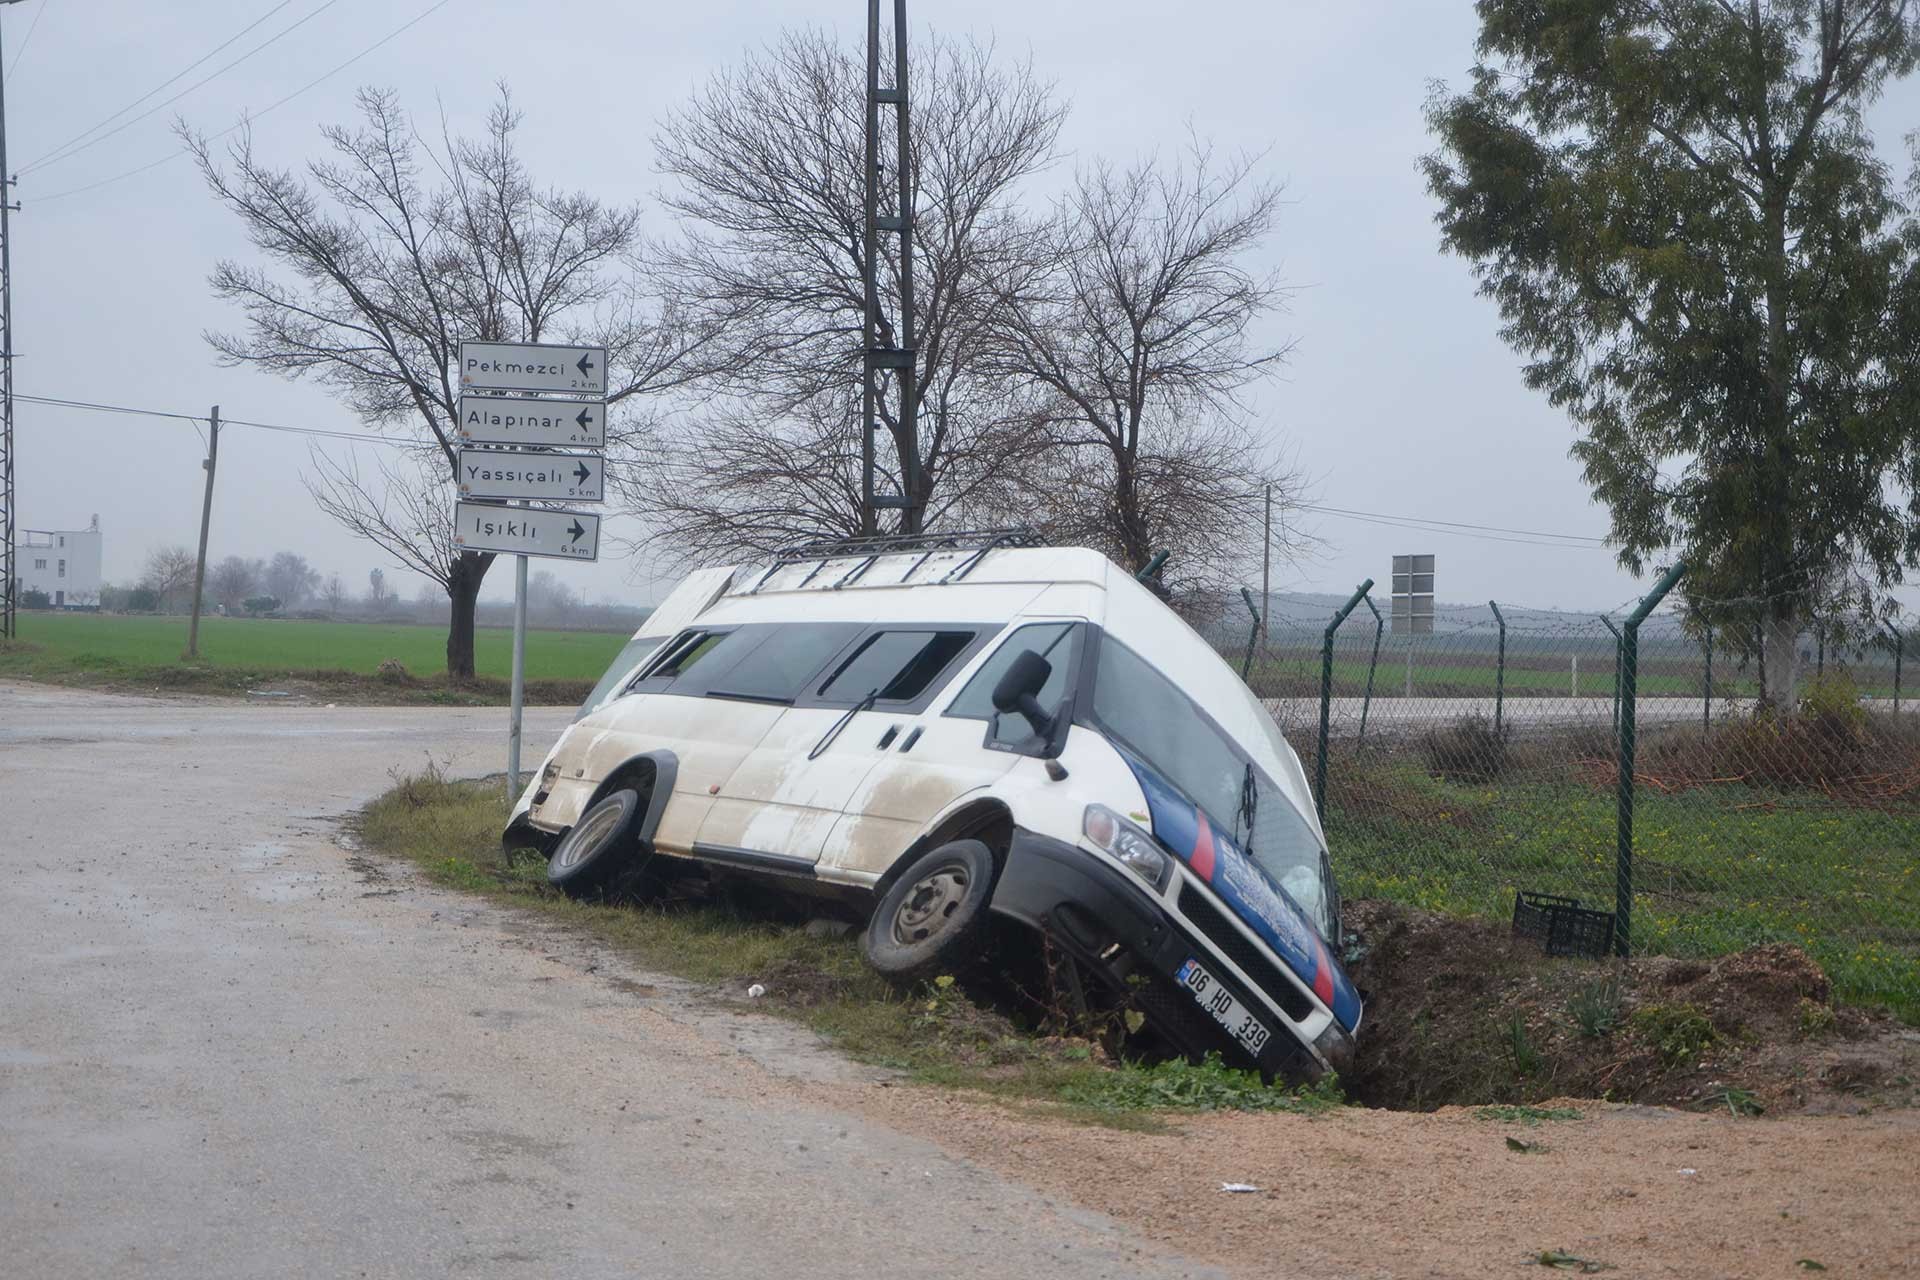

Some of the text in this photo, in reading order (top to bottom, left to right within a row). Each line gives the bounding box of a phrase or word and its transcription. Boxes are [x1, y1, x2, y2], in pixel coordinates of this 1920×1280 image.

[467, 359, 564, 375] Pekmezci
[571, 380, 598, 389] 2 km
[468, 411, 563, 429] Alapınar
[570, 434, 598, 443] 4 km
[467, 466, 562, 483] Yassıçalı
[569, 488, 595, 497] 5 km
[476, 517, 536, 538] Işıklı
[560, 545, 589, 555] 6 km
[1188, 967, 1210, 993] 06
[1210, 988, 1232, 1014] HD
[1239, 1015, 1267, 1047] 339
